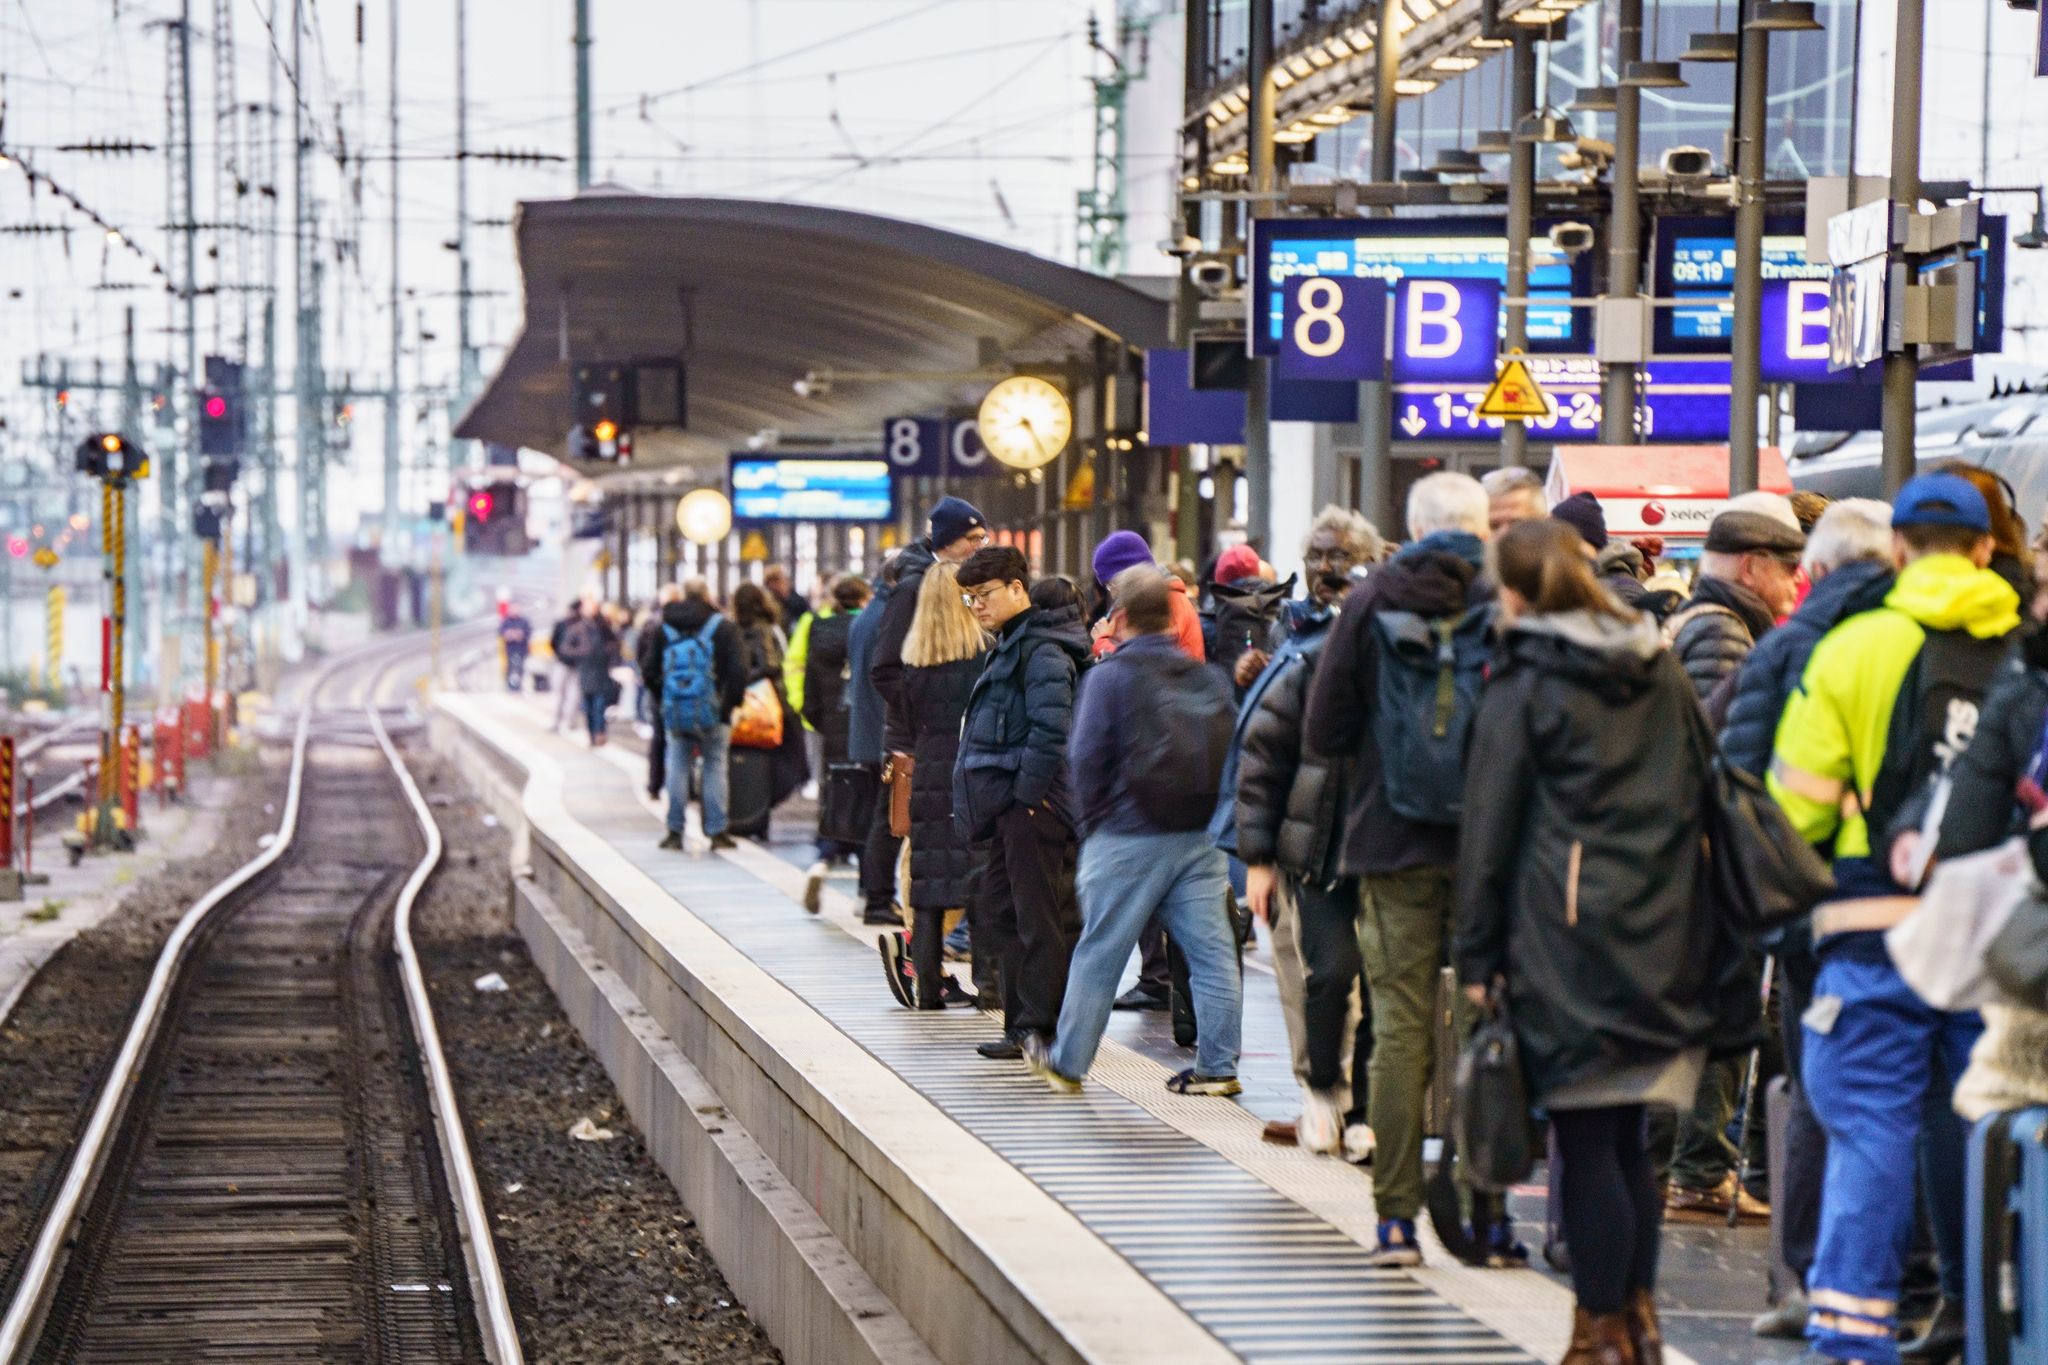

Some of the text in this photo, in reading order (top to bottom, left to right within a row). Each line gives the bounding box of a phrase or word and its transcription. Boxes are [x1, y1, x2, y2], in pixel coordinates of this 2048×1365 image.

[1673, 260, 1724, 282] 09:19
[1294, 277, 1464, 359] 8 B
[889, 418, 987, 467] 8 C
